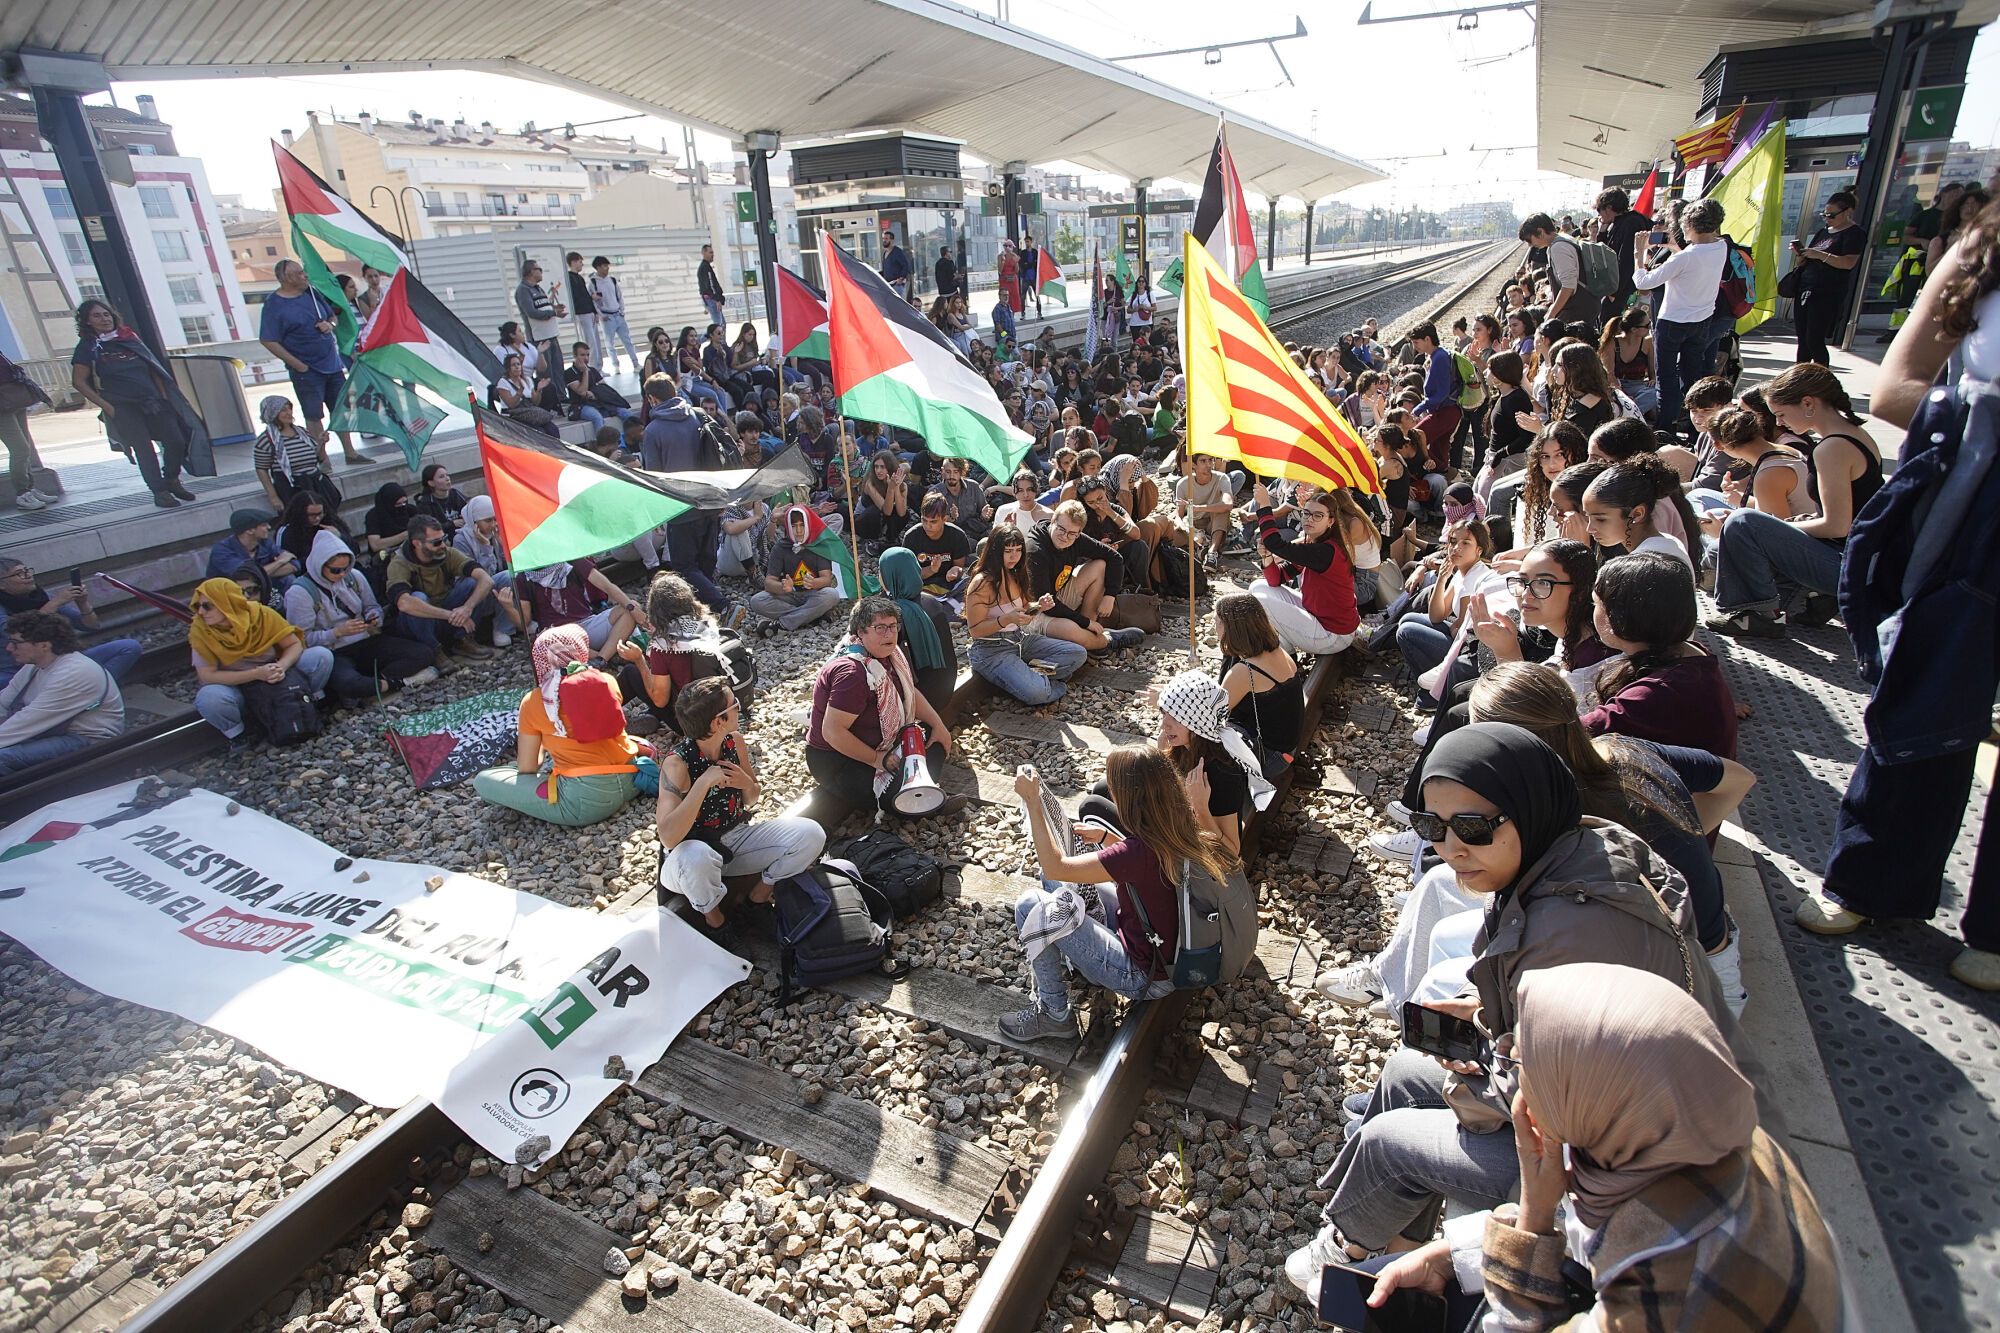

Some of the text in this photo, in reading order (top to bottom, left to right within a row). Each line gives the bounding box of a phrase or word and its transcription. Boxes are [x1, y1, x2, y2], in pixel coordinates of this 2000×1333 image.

[1622, 178, 1645, 186] Girona
[77, 855, 179, 904] ATUREM
[160, 896, 207, 923] EL
[194, 916, 300, 948] GENOCIDI
[122, 825, 284, 907] PALESTINA
[267, 891, 382, 926] LLIURE
[361, 908, 440, 950] DEL
[431, 933, 509, 966] RIU
[579, 946, 651, 1008] AR
[481, 1102, 536, 1139] SALVADORA CAT
[492, 1102, 536, 1133] ATENEU POPULAR
